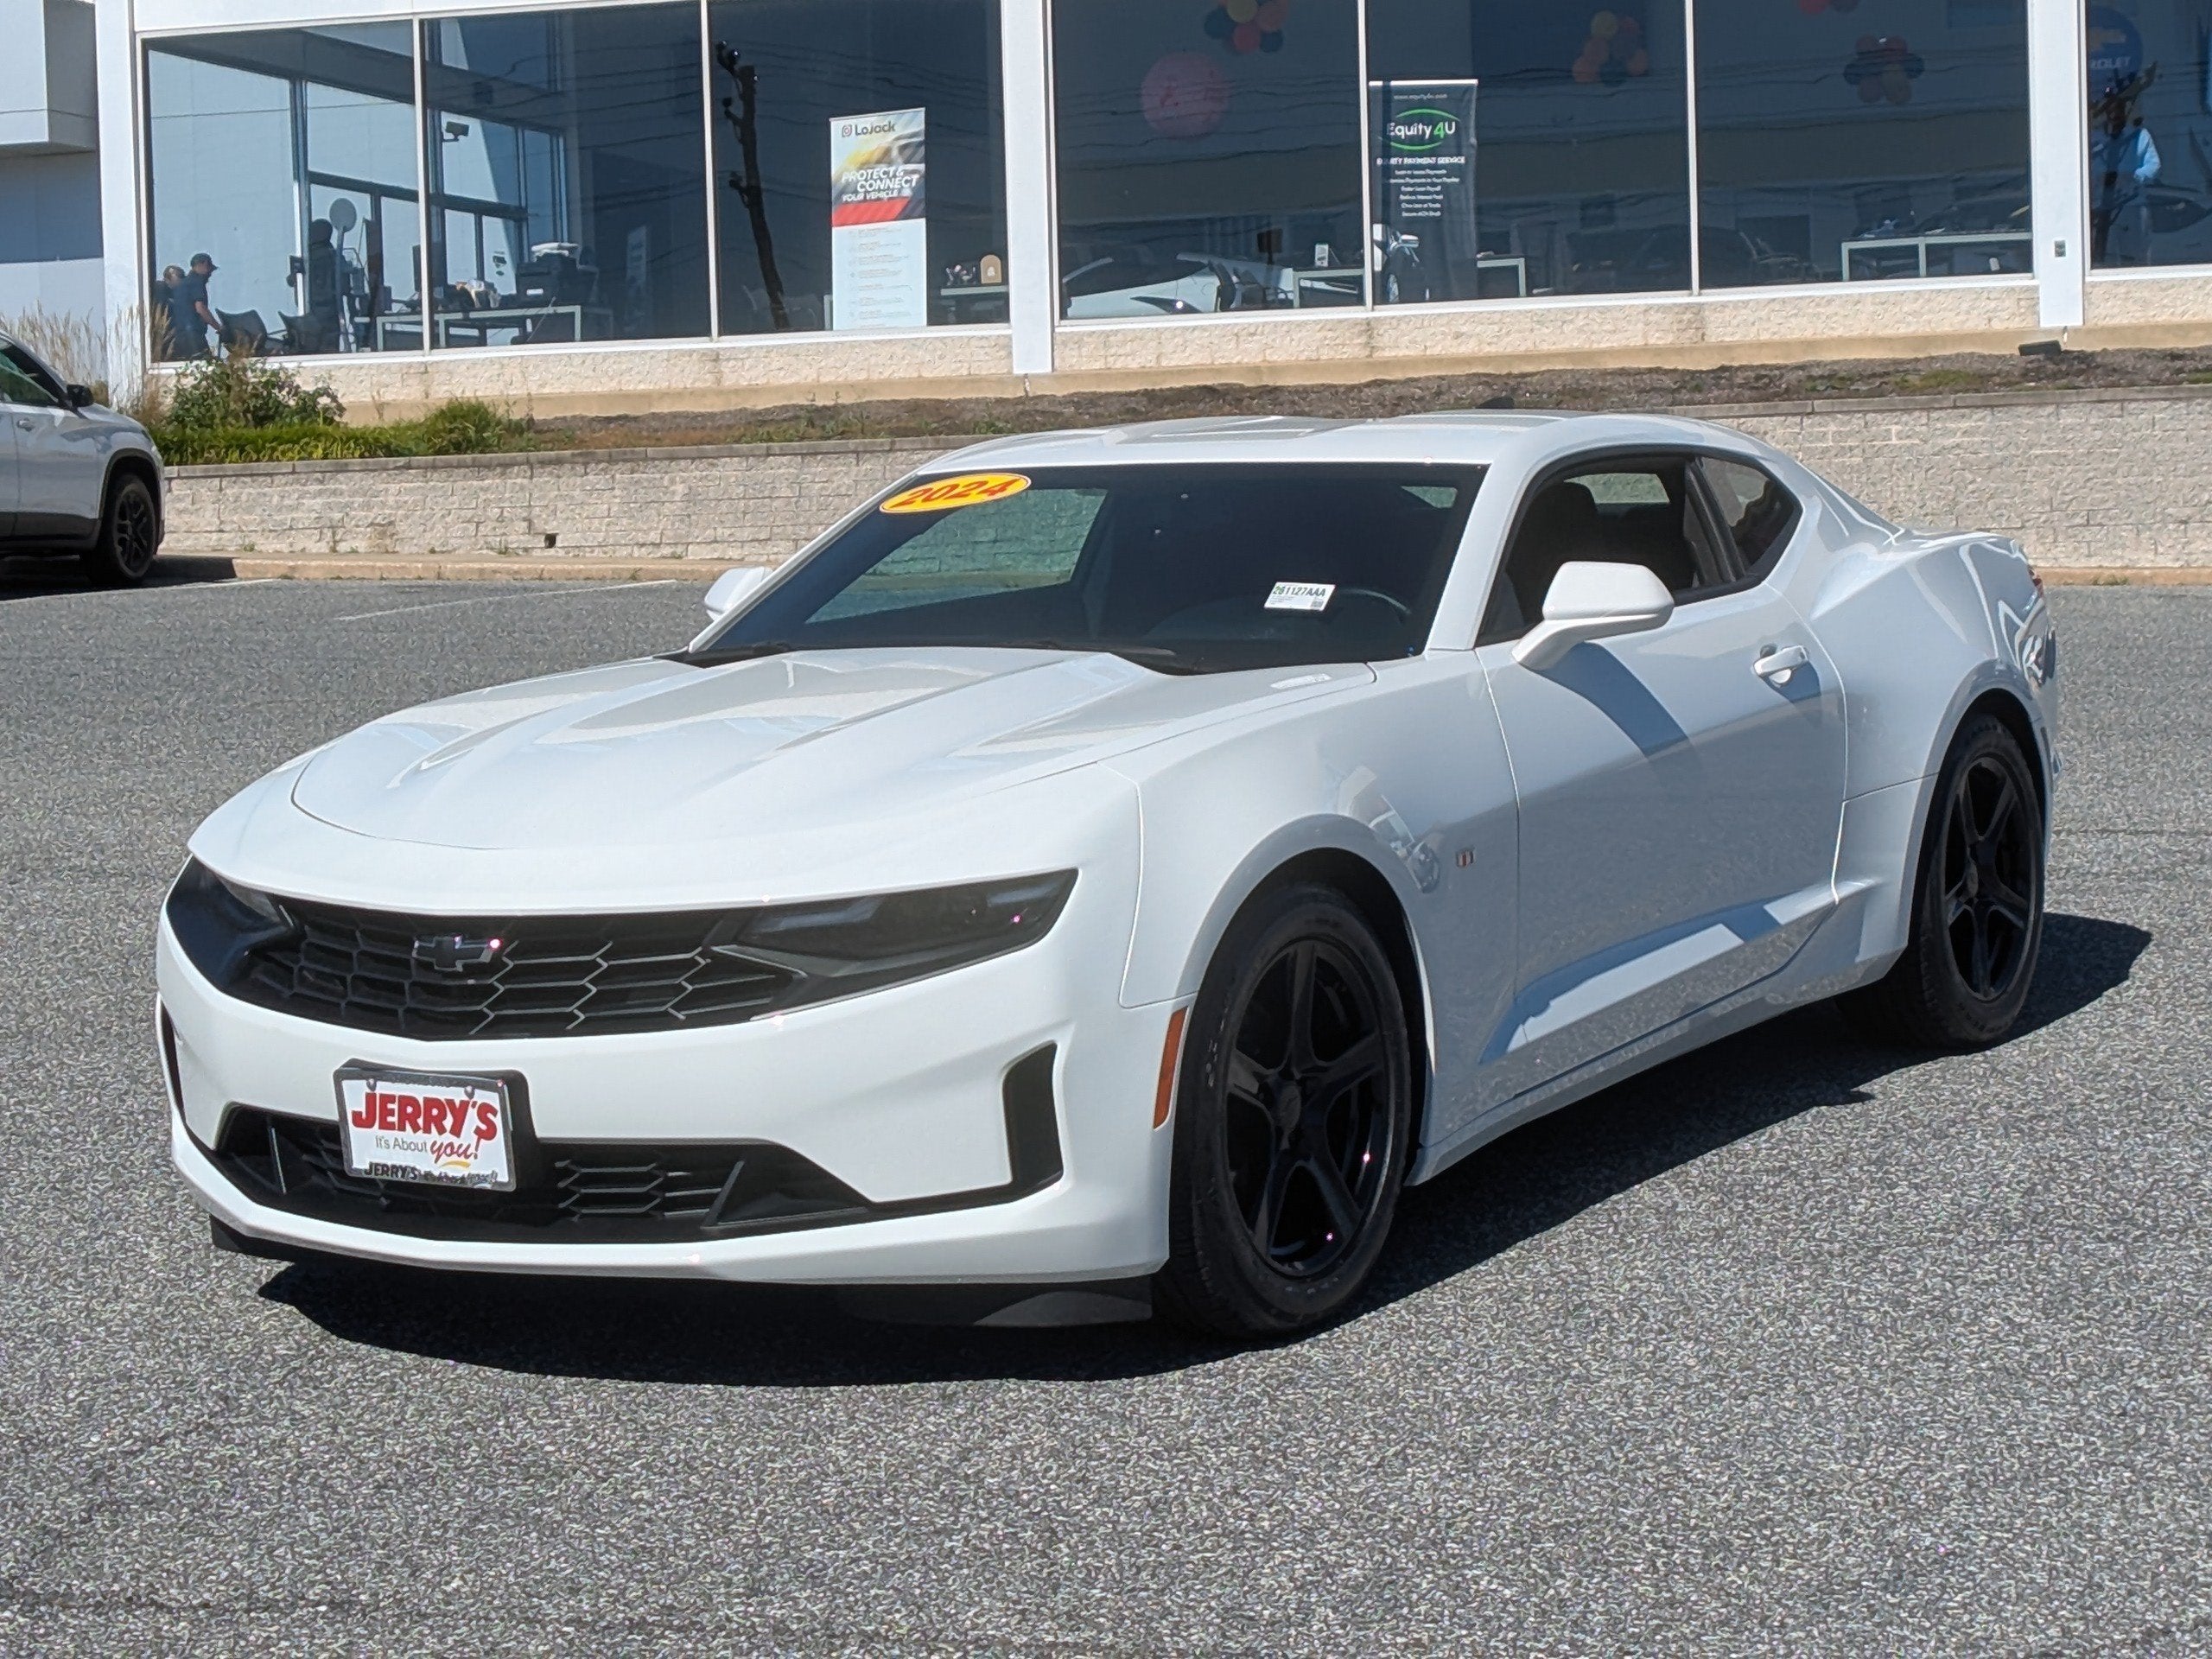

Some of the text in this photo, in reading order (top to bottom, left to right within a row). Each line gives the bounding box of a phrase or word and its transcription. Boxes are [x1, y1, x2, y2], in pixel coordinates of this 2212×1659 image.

[841, 167, 896, 183] PROTECT
[856, 174, 921, 193] CONNECT
[842, 189, 899, 202] YOUR VEHICLE
[888, 478, 1021, 509] 2024
[351, 1091, 499, 1141] JERRY'S
[375, 1135, 481, 1164] It's About you!
